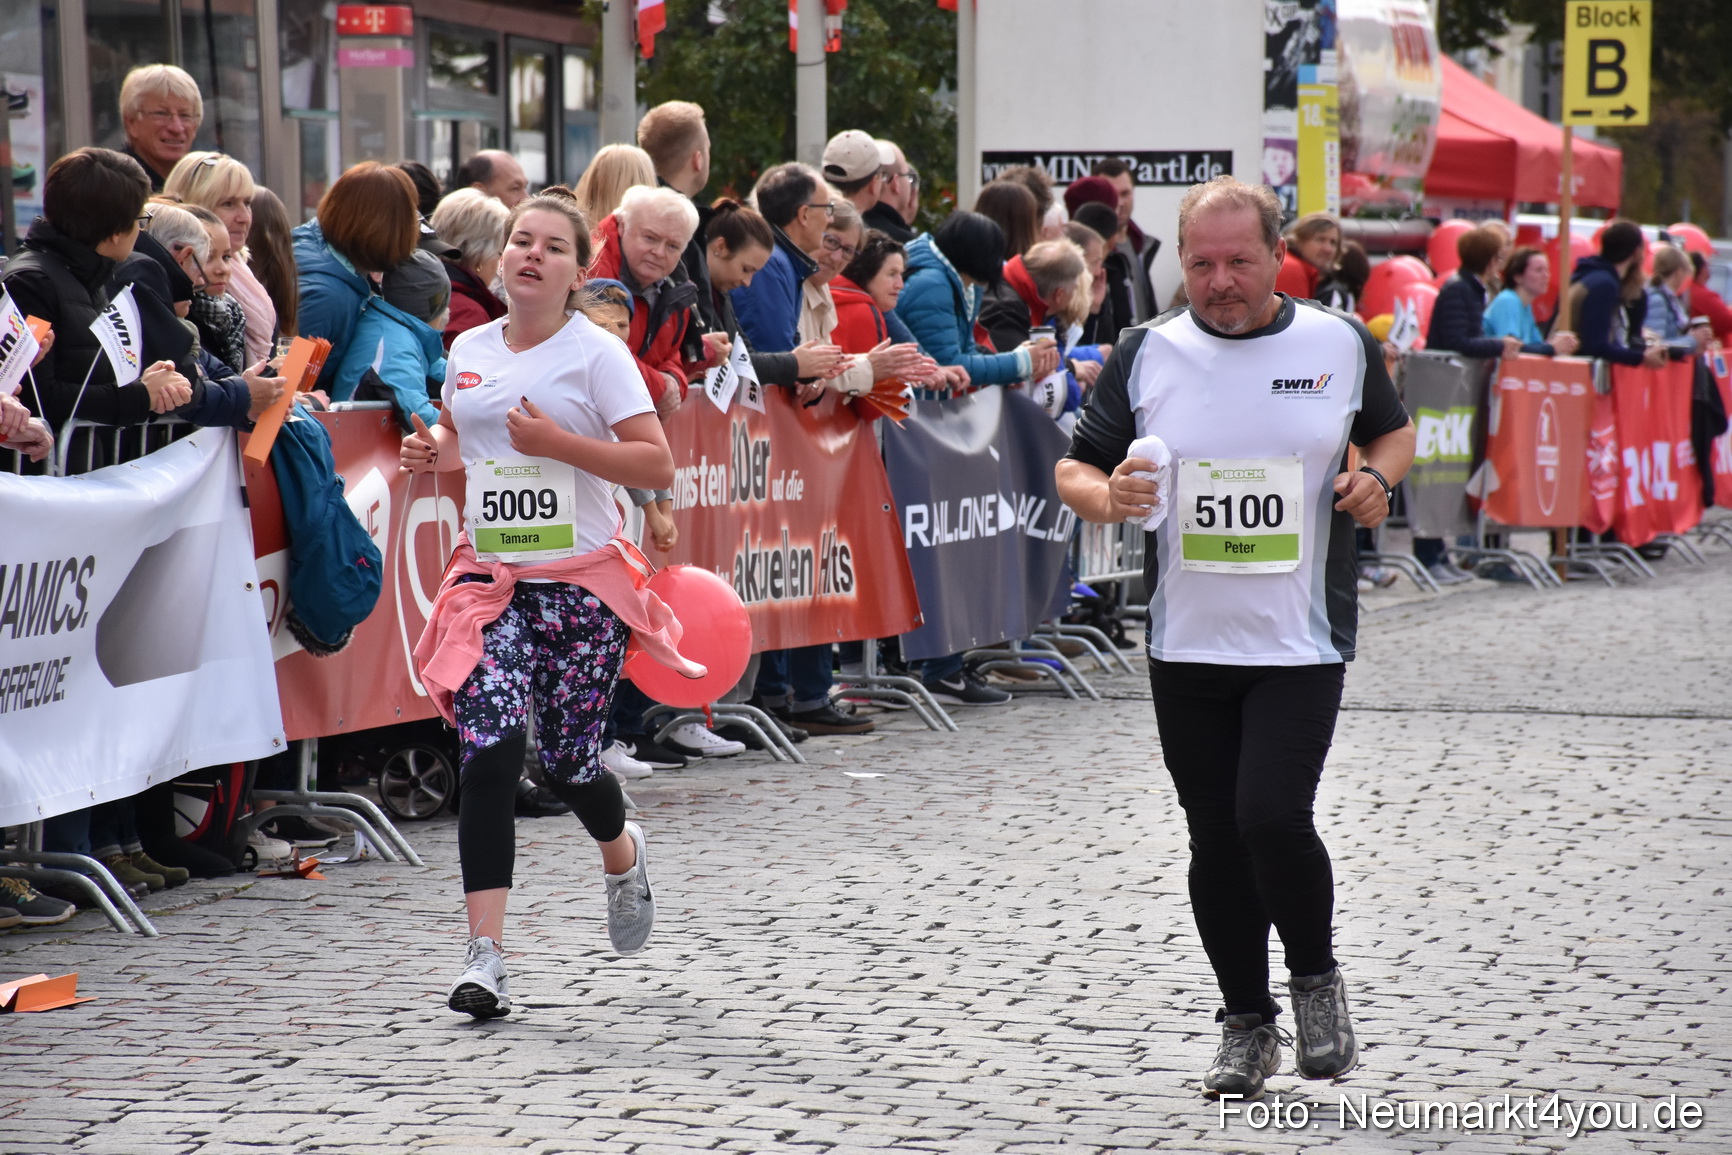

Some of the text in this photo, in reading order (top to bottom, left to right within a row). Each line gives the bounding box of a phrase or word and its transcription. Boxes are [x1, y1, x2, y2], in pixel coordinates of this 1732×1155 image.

[364, 7, 385, 33] T
[1577, 5, 1640, 27] Block
[1587, 38, 1627, 97] B
[1271, 378, 1314, 390] swn
[503, 465, 541, 476] BOCK
[1223, 469, 1266, 479] BOCK
[482, 488, 558, 522] 5009
[1195, 493, 1284, 529] 5100
[500, 533, 540, 545] Tamara
[1224, 541, 1256, 554] Peter
[0, 554, 95, 640] AMICS.
